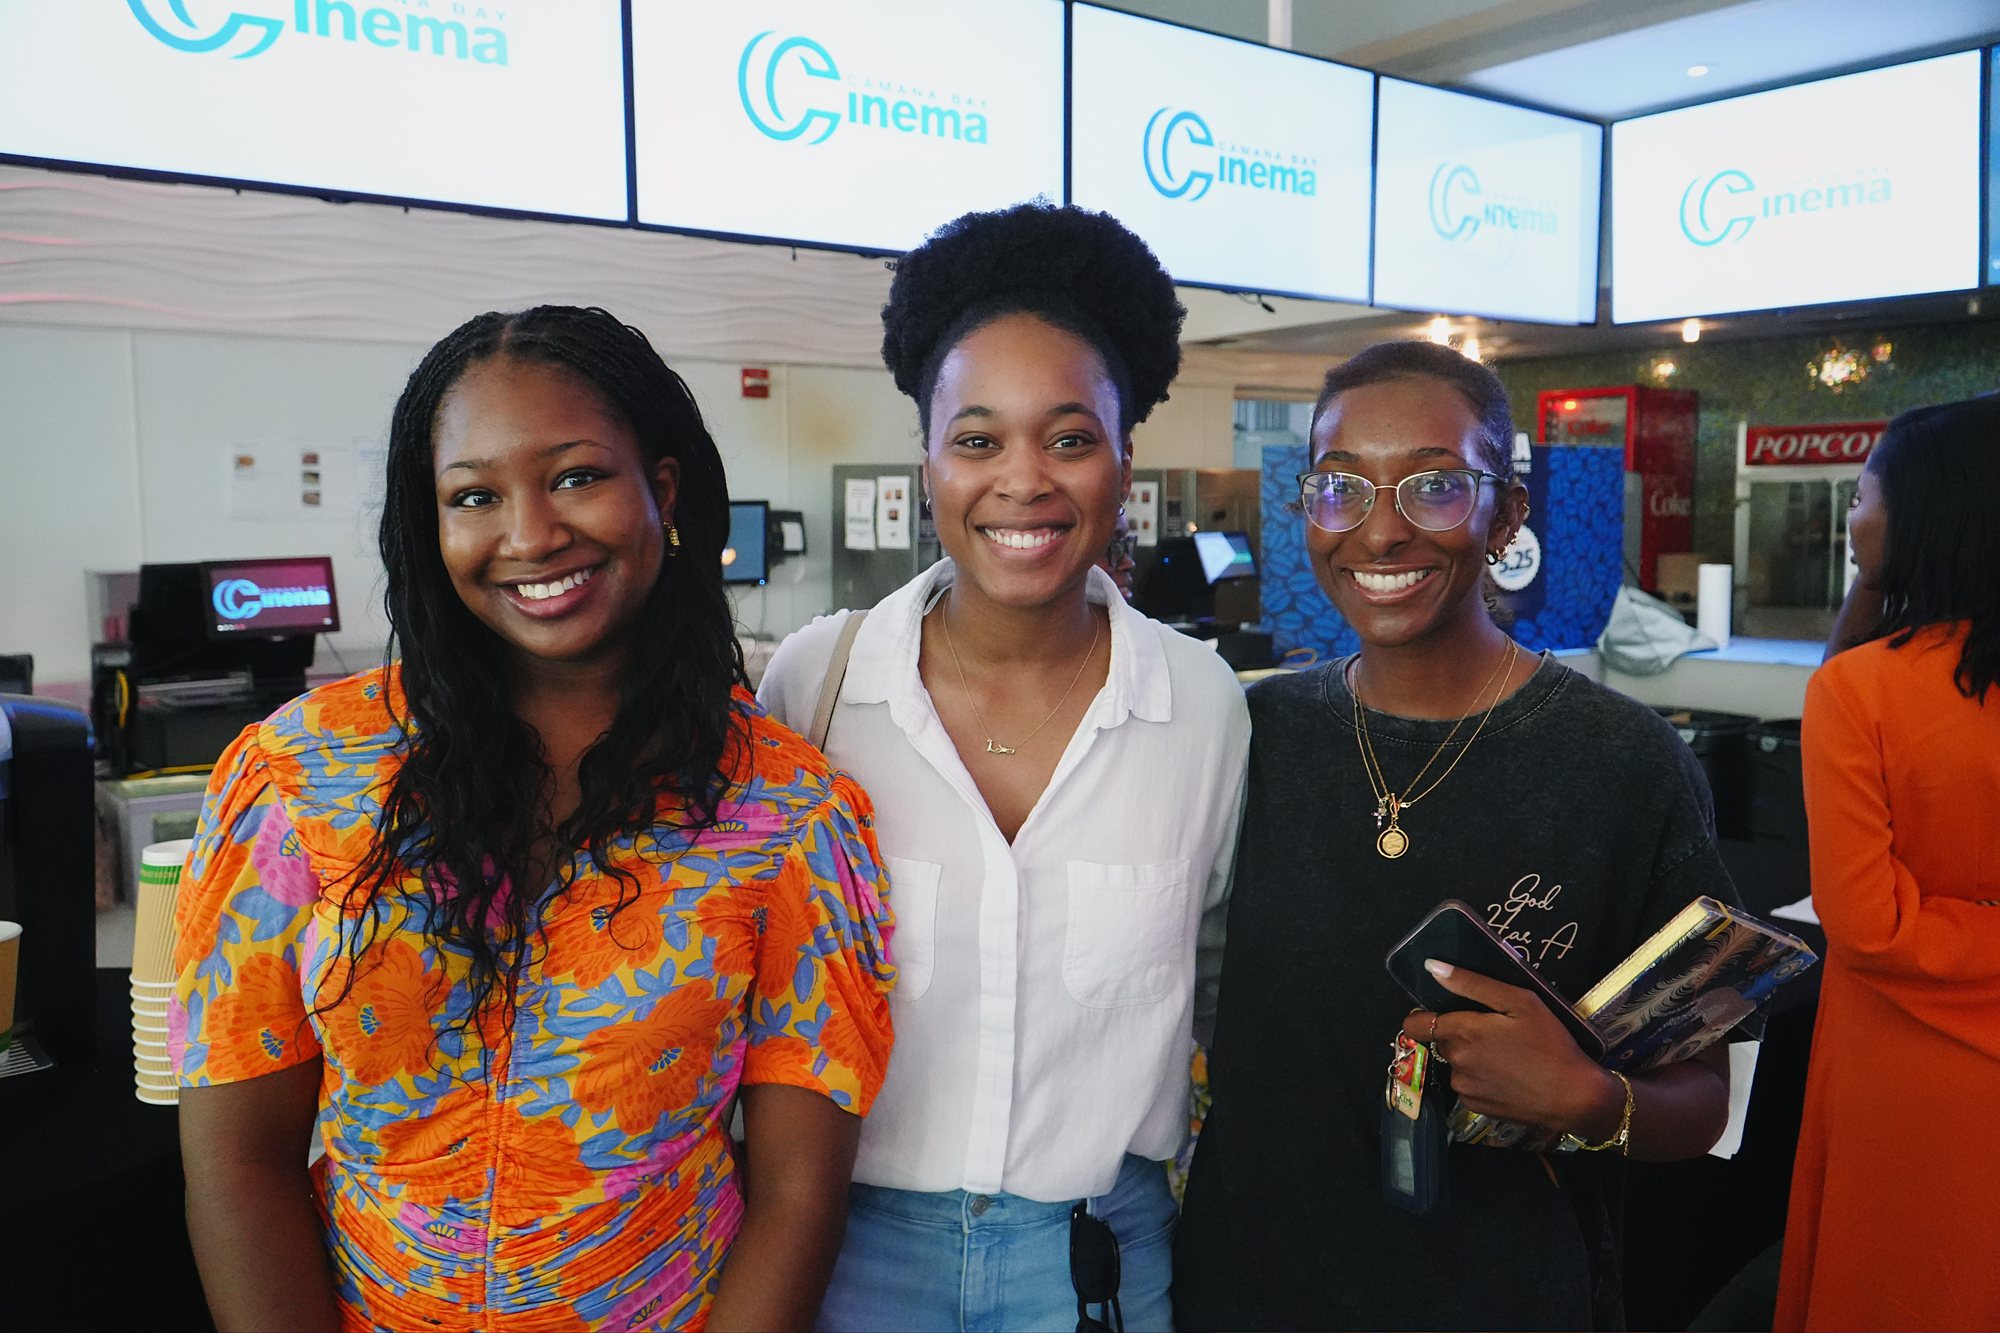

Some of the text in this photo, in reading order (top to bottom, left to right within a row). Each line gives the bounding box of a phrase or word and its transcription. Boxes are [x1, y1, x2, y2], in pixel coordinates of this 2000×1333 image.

[1752, 431, 1884, 460] POPCO
[1504, 873, 1562, 912] God
[1539, 921, 1579, 960] A
